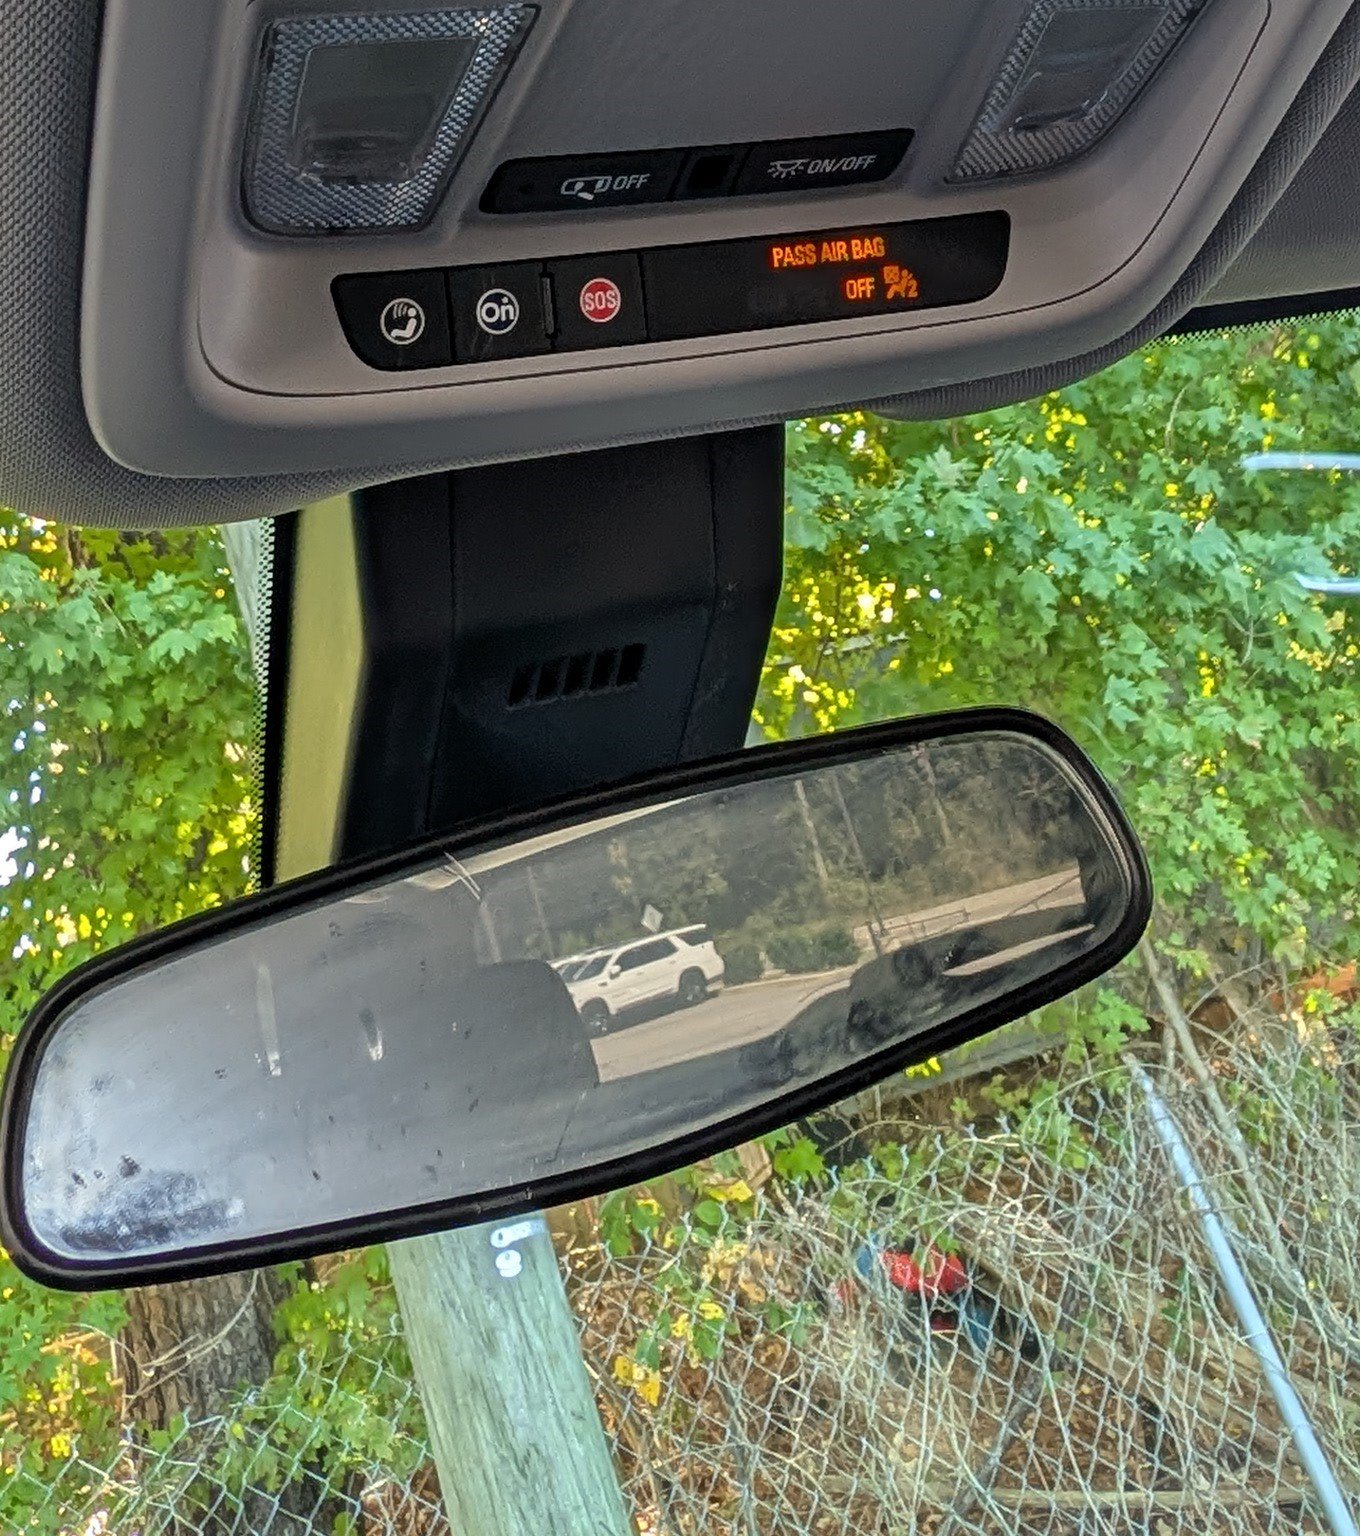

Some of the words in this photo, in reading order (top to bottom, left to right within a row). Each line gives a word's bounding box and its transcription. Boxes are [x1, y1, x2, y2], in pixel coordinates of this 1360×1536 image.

[807, 154, 877, 174] ON/OFF
[612, 173, 650, 191] OFF
[772, 243, 817, 268] PASS
[821, 241, 849, 262] AIR
[851, 237, 886, 260] BAG
[845, 277, 875, 300] OFF
[481, 297, 515, 323] On
[584, 291, 617, 312] SOS
